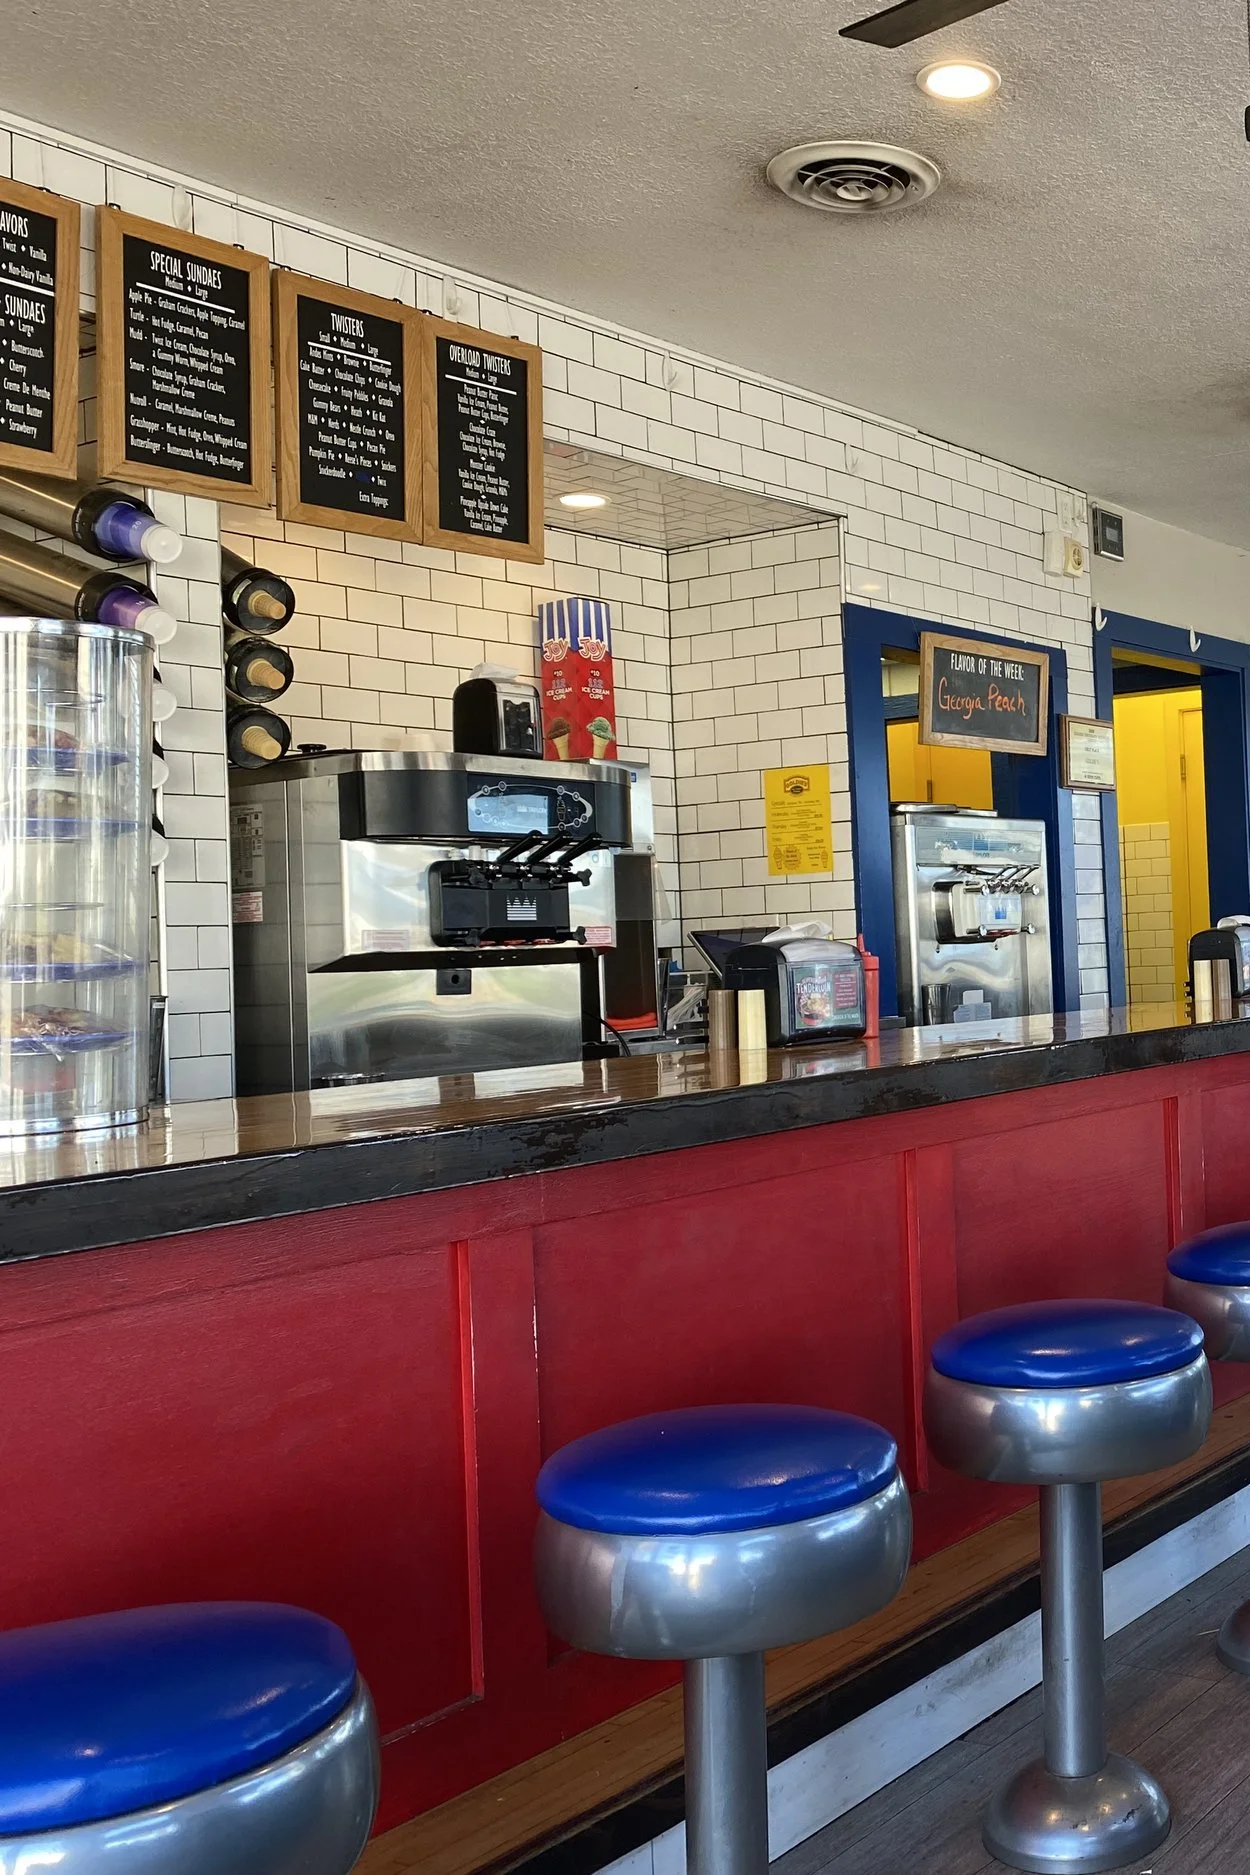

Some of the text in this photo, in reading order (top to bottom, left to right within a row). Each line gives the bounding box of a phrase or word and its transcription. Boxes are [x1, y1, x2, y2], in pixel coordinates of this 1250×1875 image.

[29, 246, 47, 262] Vanilla
[150, 251, 222, 290] SPECIAL SUNDAES
[165, 276, 208, 300] Medium Large
[5, 294, 46, 324] SUNDAES
[129, 288, 142, 303] Apple
[144, 292, 152, 304] Pie
[158, 297, 176, 310] Graham
[197, 308, 208, 322] Apple
[228, 316, 245, 330] Caramel
[18, 319, 34, 338] Large
[130, 308, 144, 322] Turtle
[152, 316, 160, 327] Hot
[196, 327, 208, 340] Pecan
[330, 312, 364, 338] TWISTERS
[320, 331, 378, 358] Small Medium Large
[9, 359, 26, 378] Cherry
[210, 362, 223, 374] Cream
[450, 344, 510, 376] OVERLOAD TWISTERS
[6, 398, 42, 418] Peanut Butter
[9, 418, 37, 439] Strawberry
[950, 653, 1024, 680] FLAVOR OF THE WEEK:
[938, 676, 1026, 720] Georgia Peach
